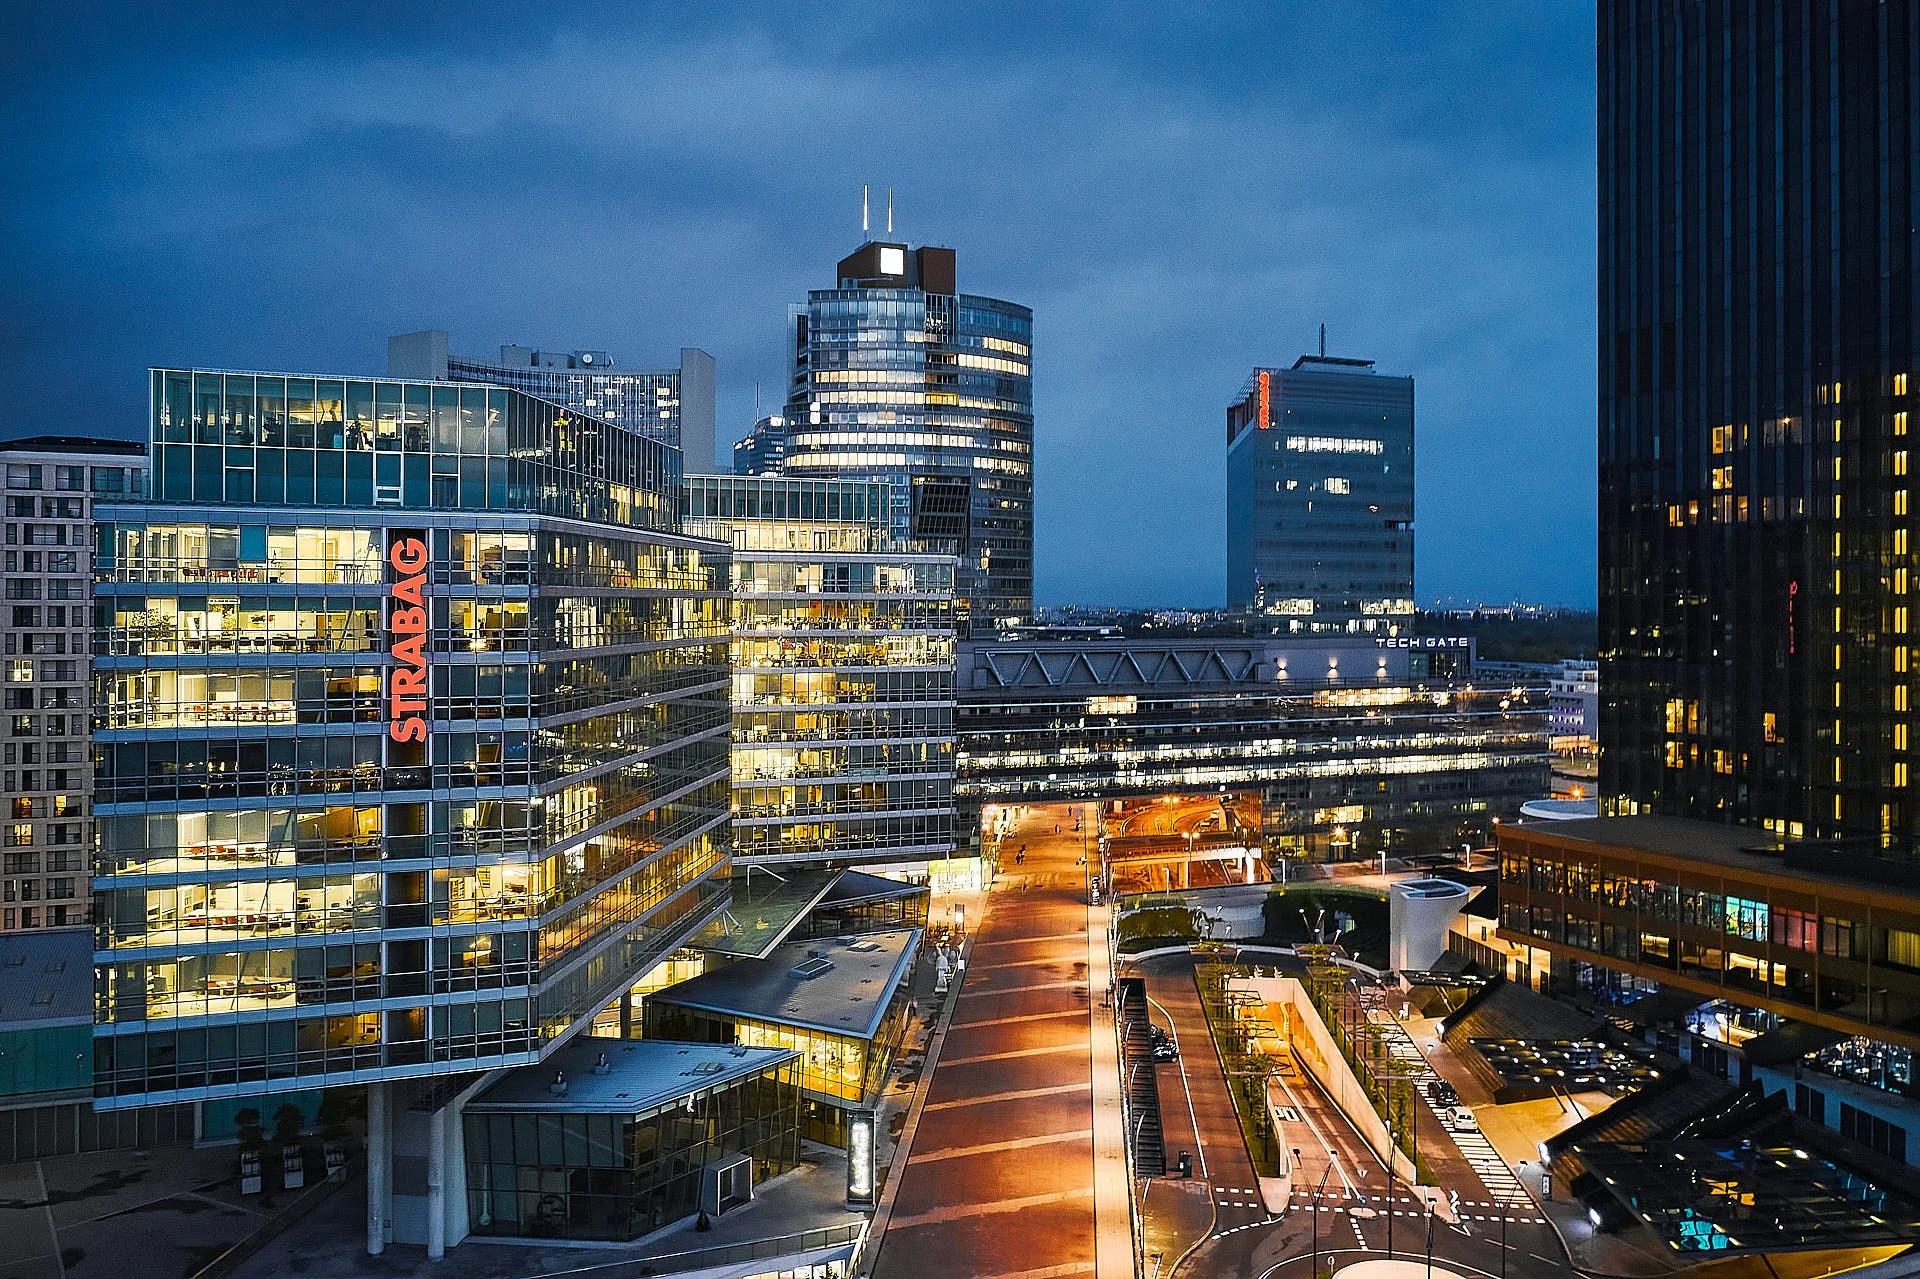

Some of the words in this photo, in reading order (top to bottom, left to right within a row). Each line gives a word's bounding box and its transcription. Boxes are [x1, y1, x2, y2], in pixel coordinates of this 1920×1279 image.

[390, 538, 428, 743] STRABAG
[1375, 637, 1420, 648] TECH
[1425, 637, 1468, 647] GATE
